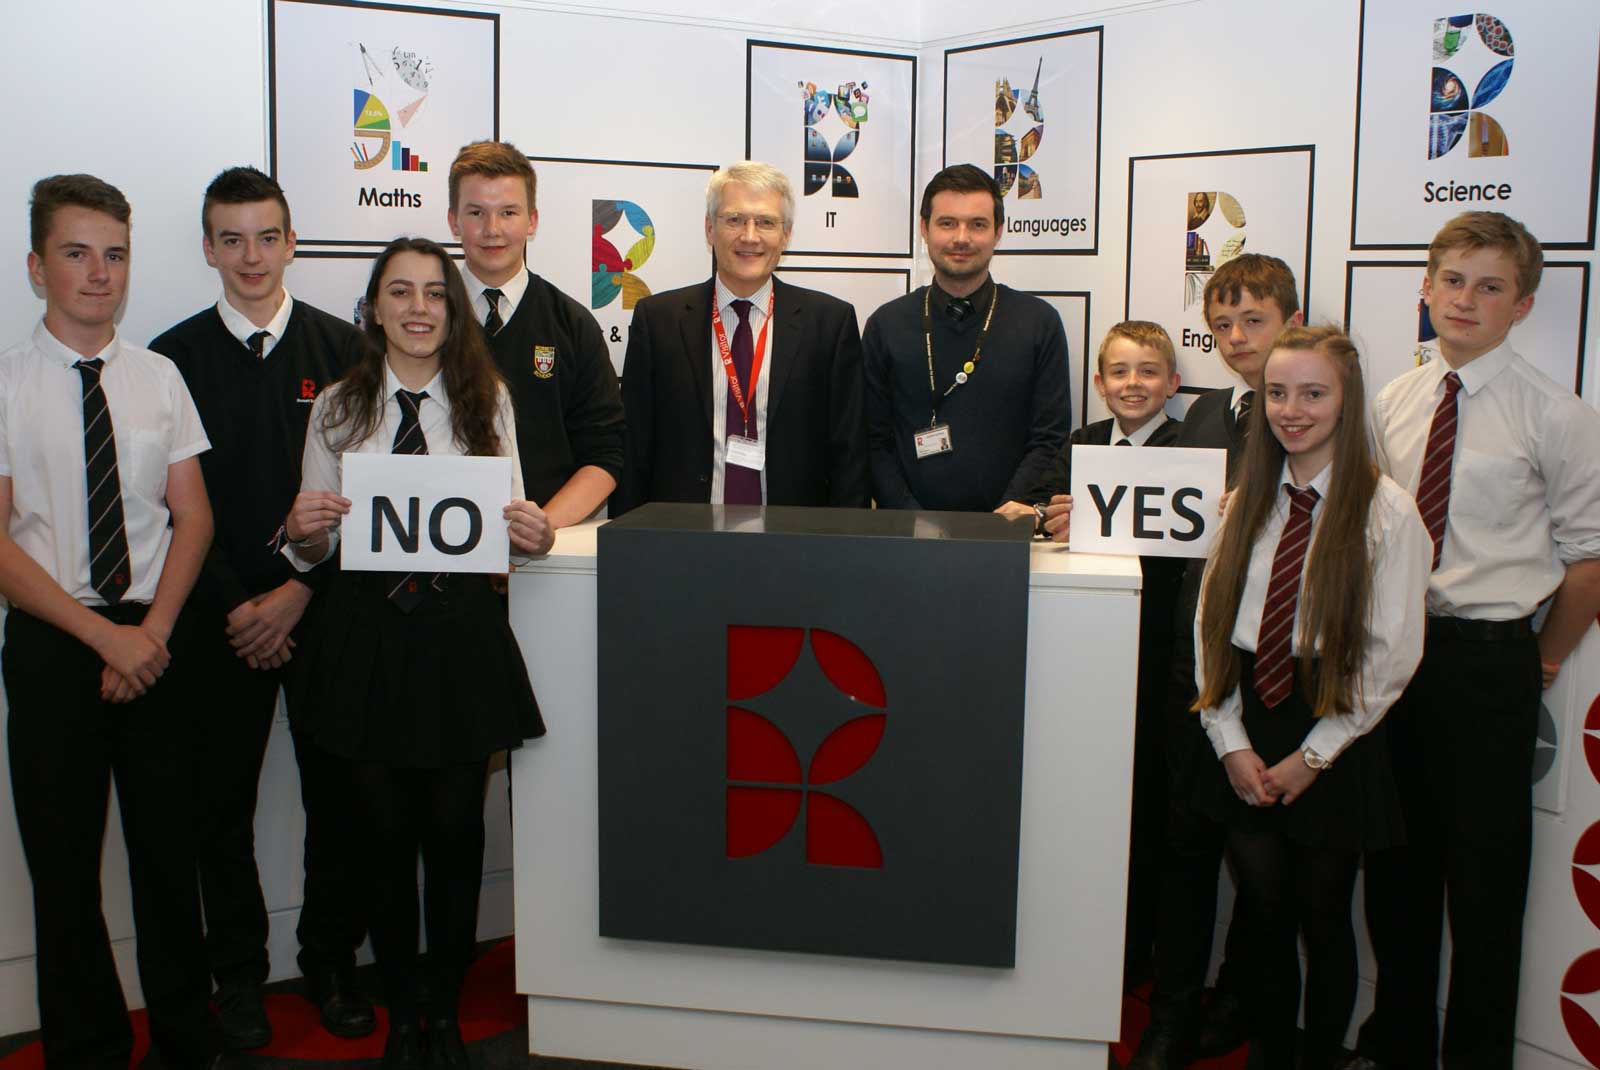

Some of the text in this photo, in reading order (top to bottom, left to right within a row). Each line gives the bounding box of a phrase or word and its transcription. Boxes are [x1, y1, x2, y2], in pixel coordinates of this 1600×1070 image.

[358, 186, 422, 208] Maths
[1423, 179, 1512, 203] Science
[825, 211, 837, 228] IT
[1007, 216, 1087, 237] Languages
[610, 326, 622, 343] &
[1087, 484, 1205, 541] YES
[371, 496, 483, 556] NO
